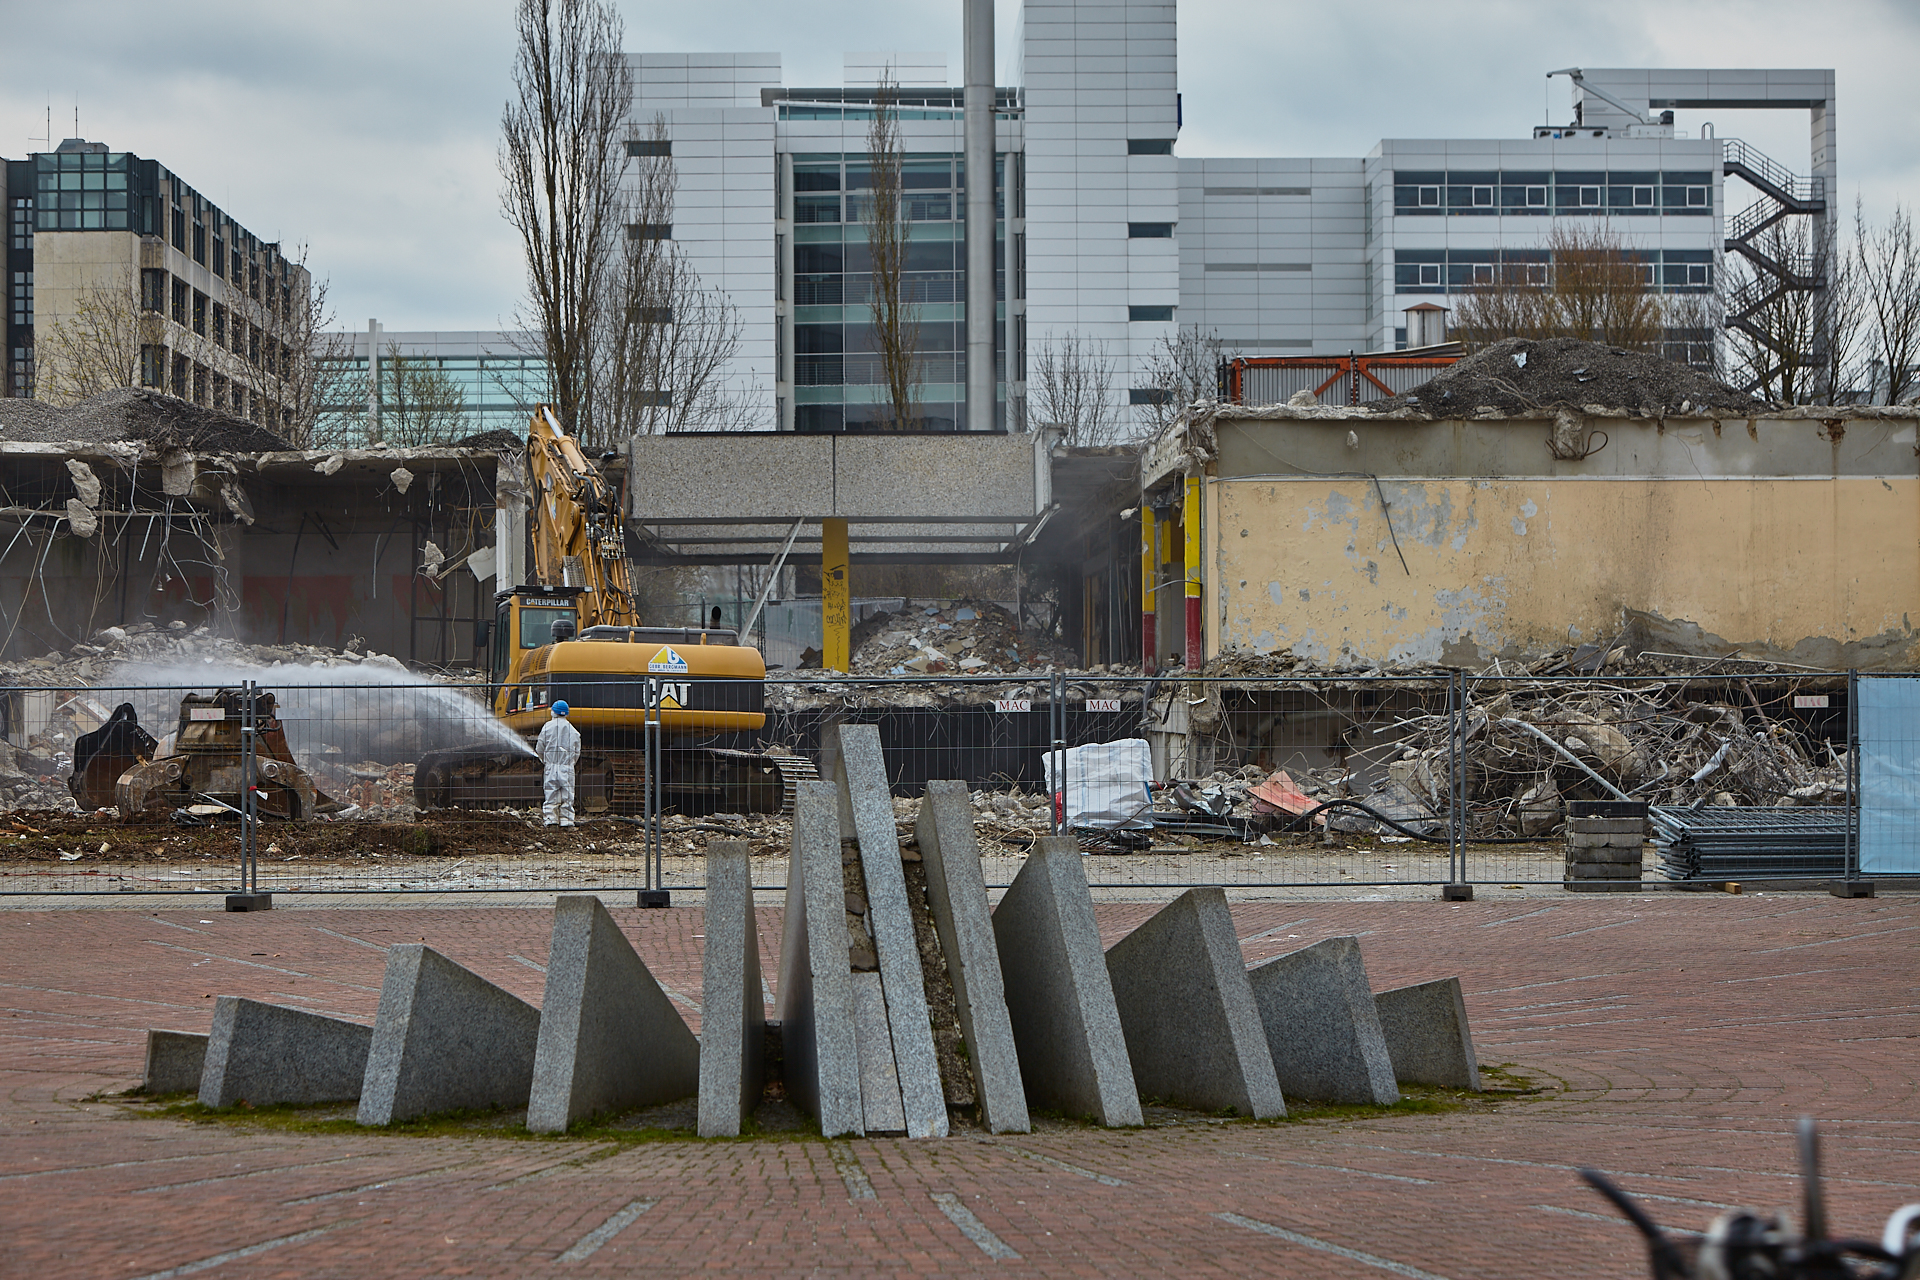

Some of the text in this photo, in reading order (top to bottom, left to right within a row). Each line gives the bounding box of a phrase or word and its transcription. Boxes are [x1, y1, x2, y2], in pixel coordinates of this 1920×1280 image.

[526, 598, 569, 607] CATERPILLAR
[643, 678, 692, 708] CAT
[999, 700, 1028, 711] MAC
[1089, 700, 1118, 711] MAC
[1797, 696, 1826, 707] MAC
[192, 709, 222, 719] MAC
